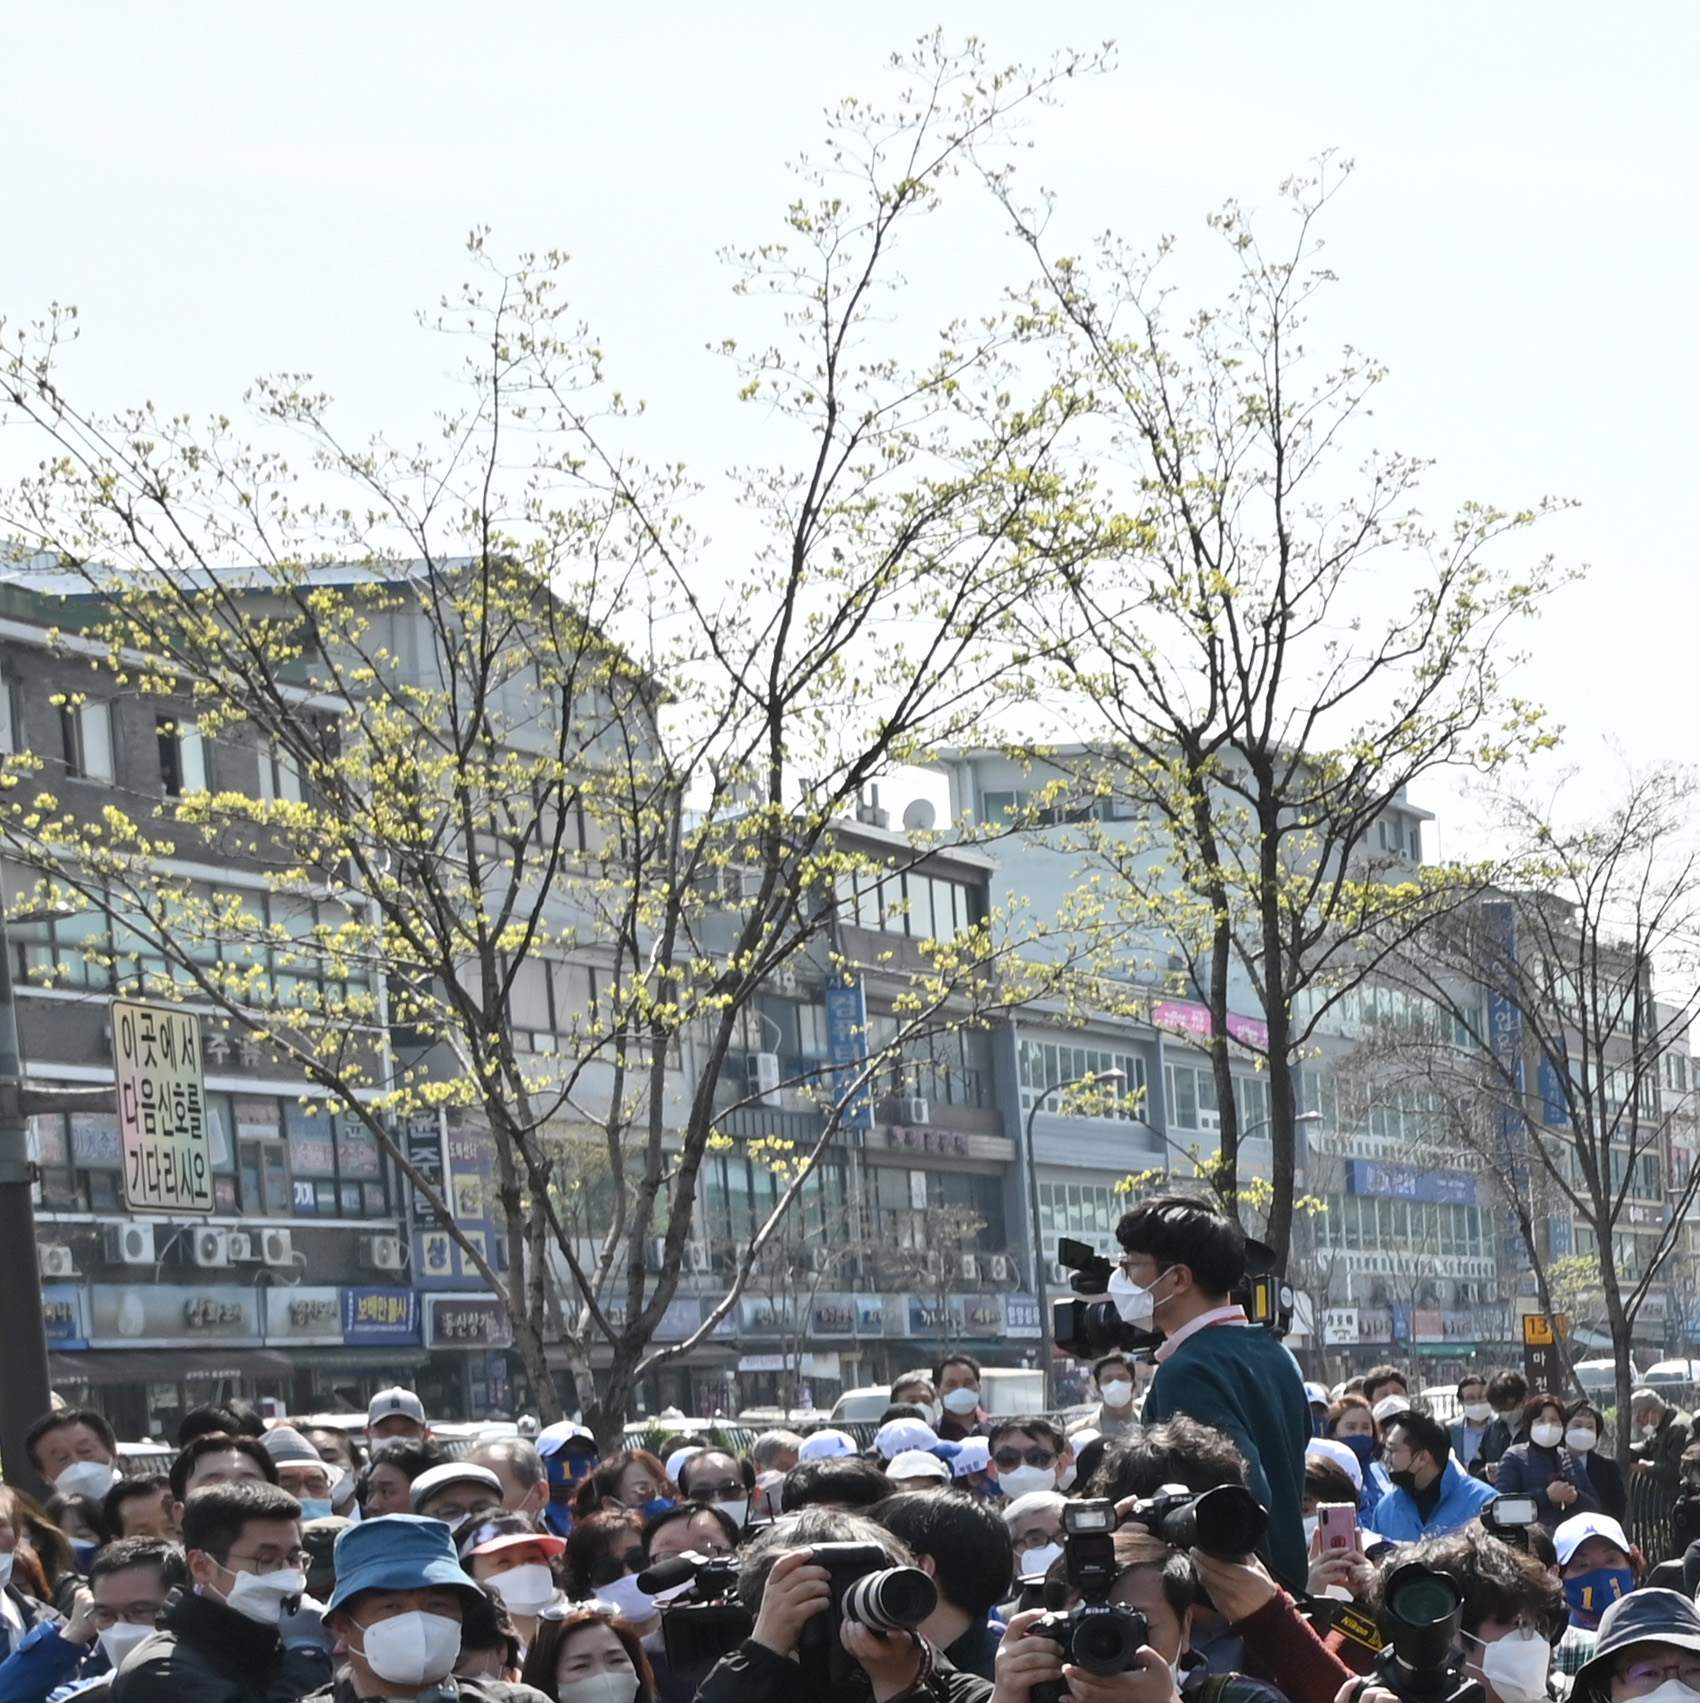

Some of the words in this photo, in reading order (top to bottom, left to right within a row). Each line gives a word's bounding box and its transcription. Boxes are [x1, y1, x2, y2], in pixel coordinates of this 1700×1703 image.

[121, 1009, 197, 1074] 이곳에서
[123, 1075, 203, 1140] 다음신호를
[129, 1144, 209, 1205] 기다리시오
